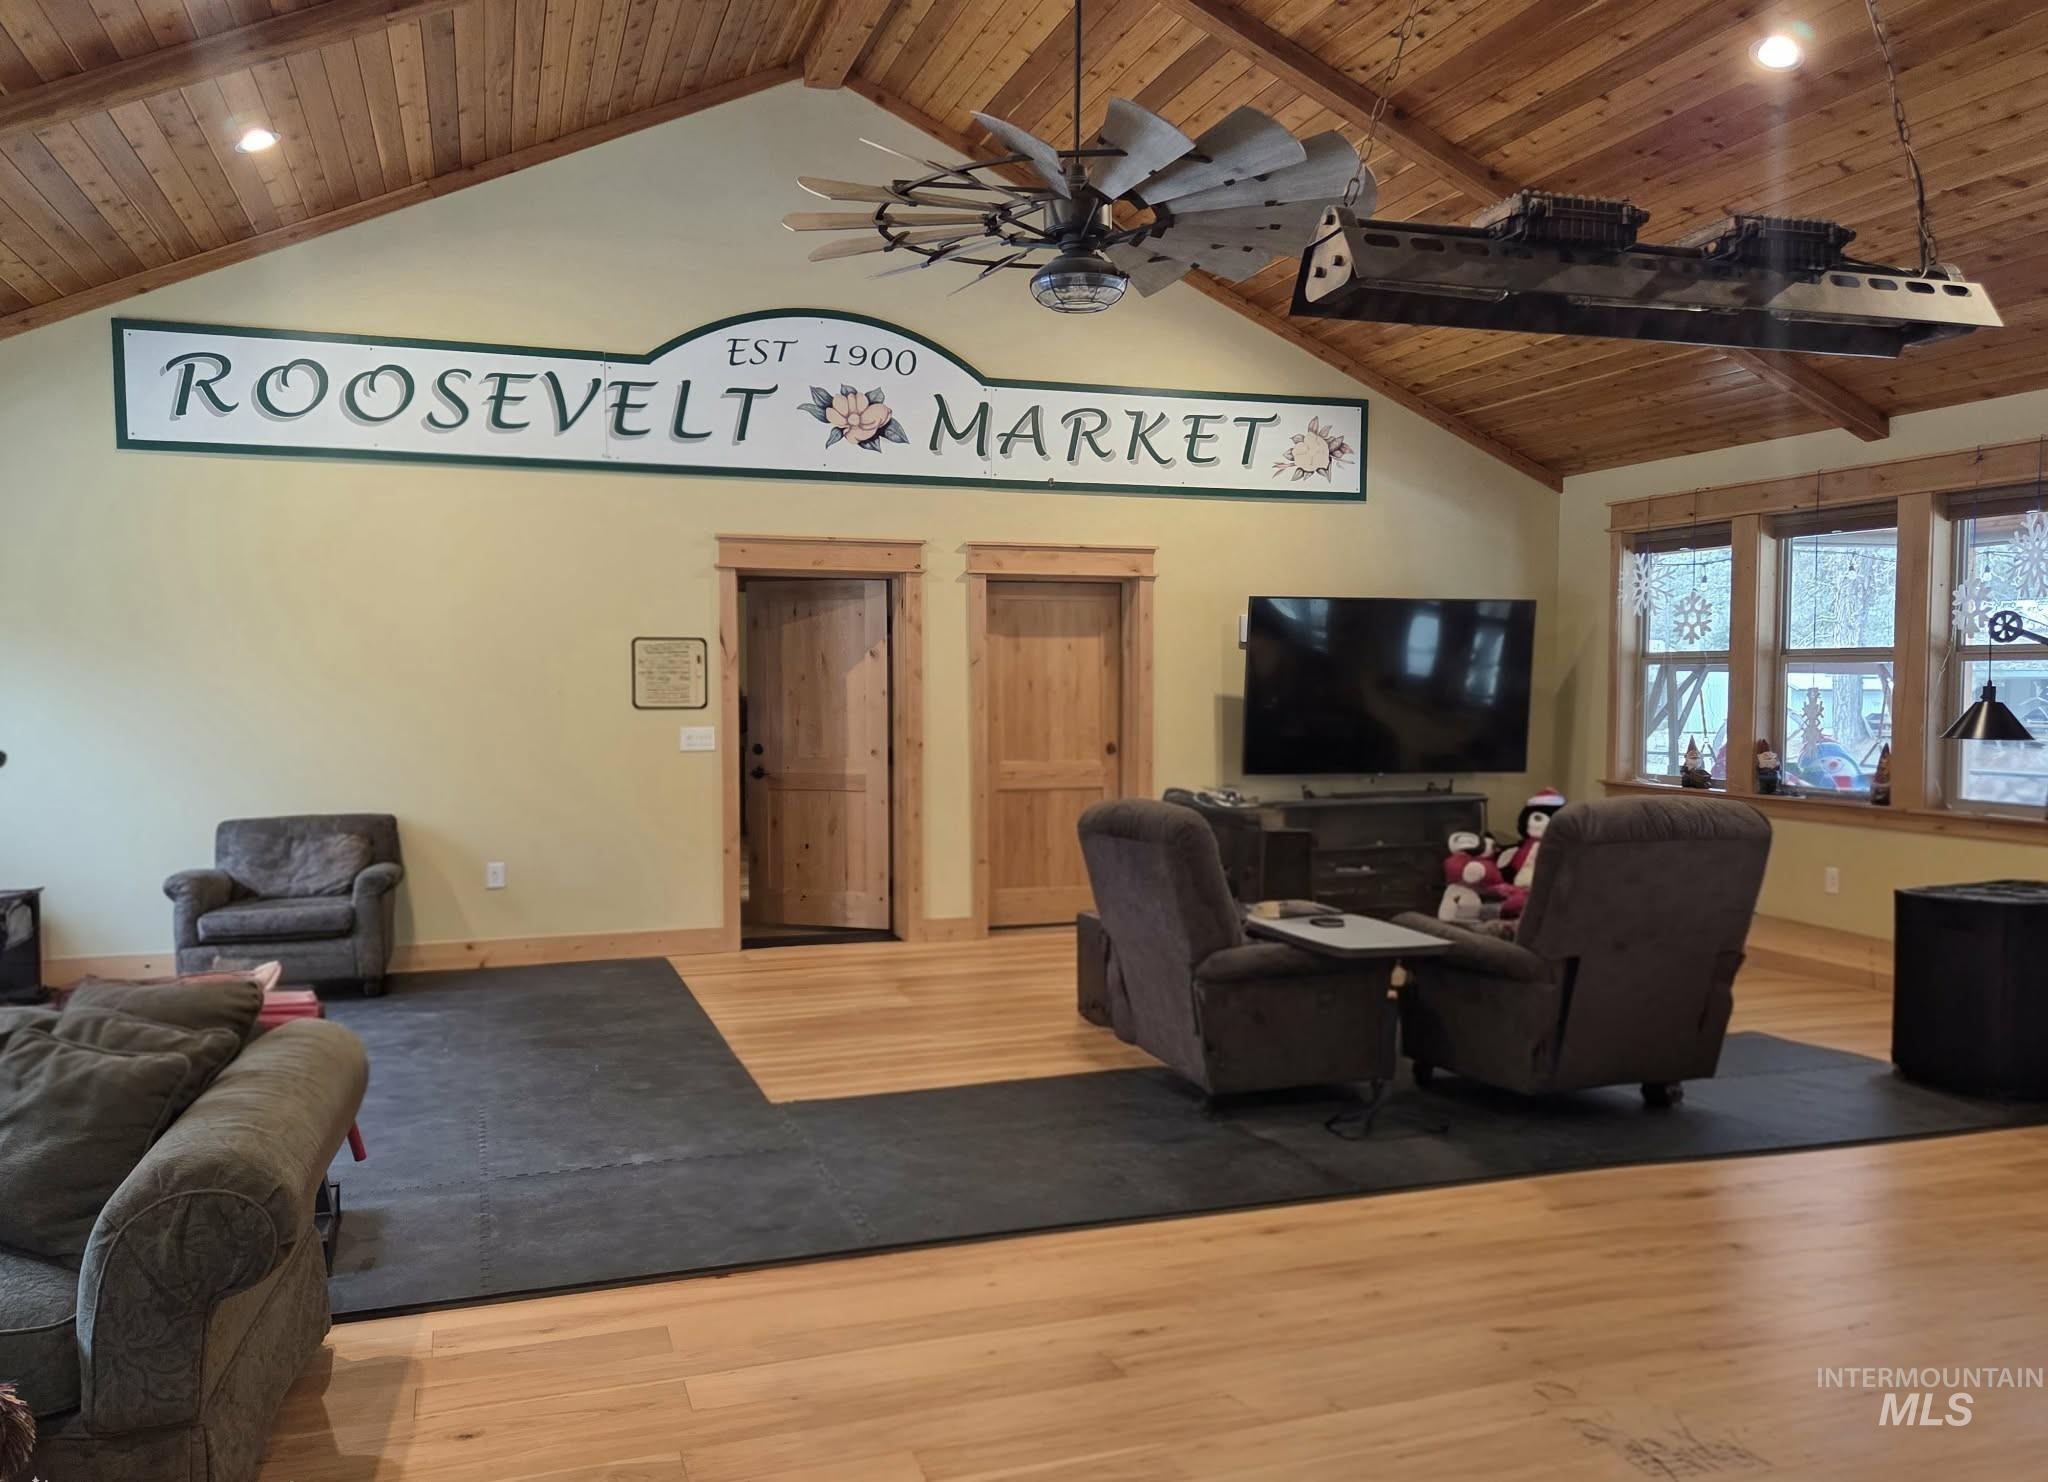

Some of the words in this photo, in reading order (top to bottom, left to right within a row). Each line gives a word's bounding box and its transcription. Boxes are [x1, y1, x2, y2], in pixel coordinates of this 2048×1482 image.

[727, 337, 799, 367] EST
[823, 342, 918, 376] 1900
[160, 351, 778, 445] ROOSEVELT
[930, 393, 1279, 468] MARKET
